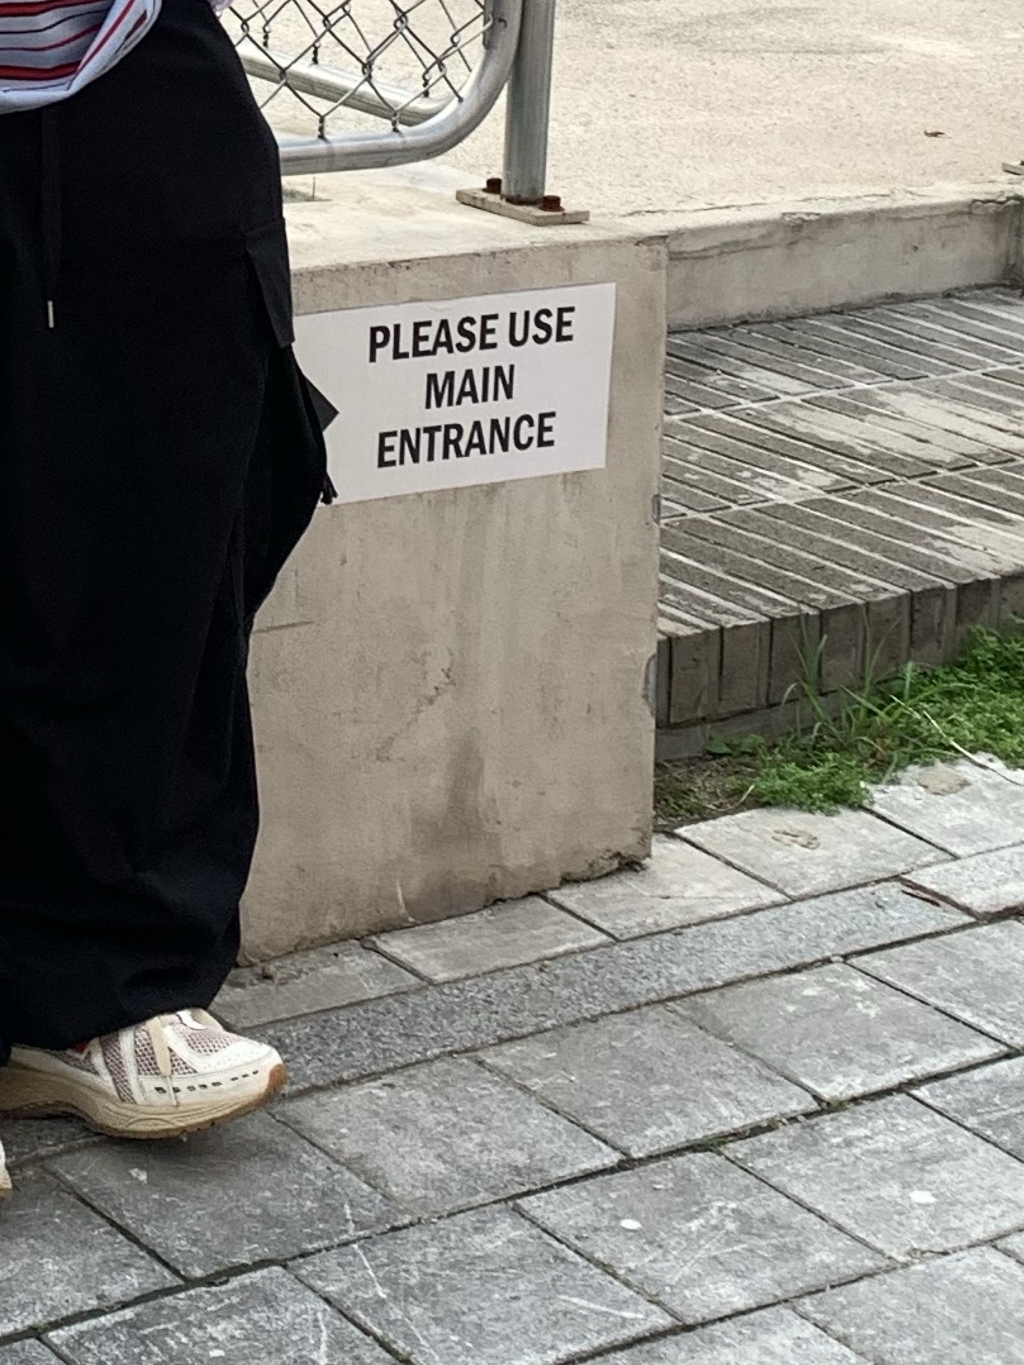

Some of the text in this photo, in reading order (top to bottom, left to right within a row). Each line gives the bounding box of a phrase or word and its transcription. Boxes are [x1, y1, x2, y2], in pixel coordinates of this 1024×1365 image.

[369, 306, 576, 363] PLEASE USE
[425, 364, 515, 410] MAIN
[377, 411, 557, 469] ENTRANCE
